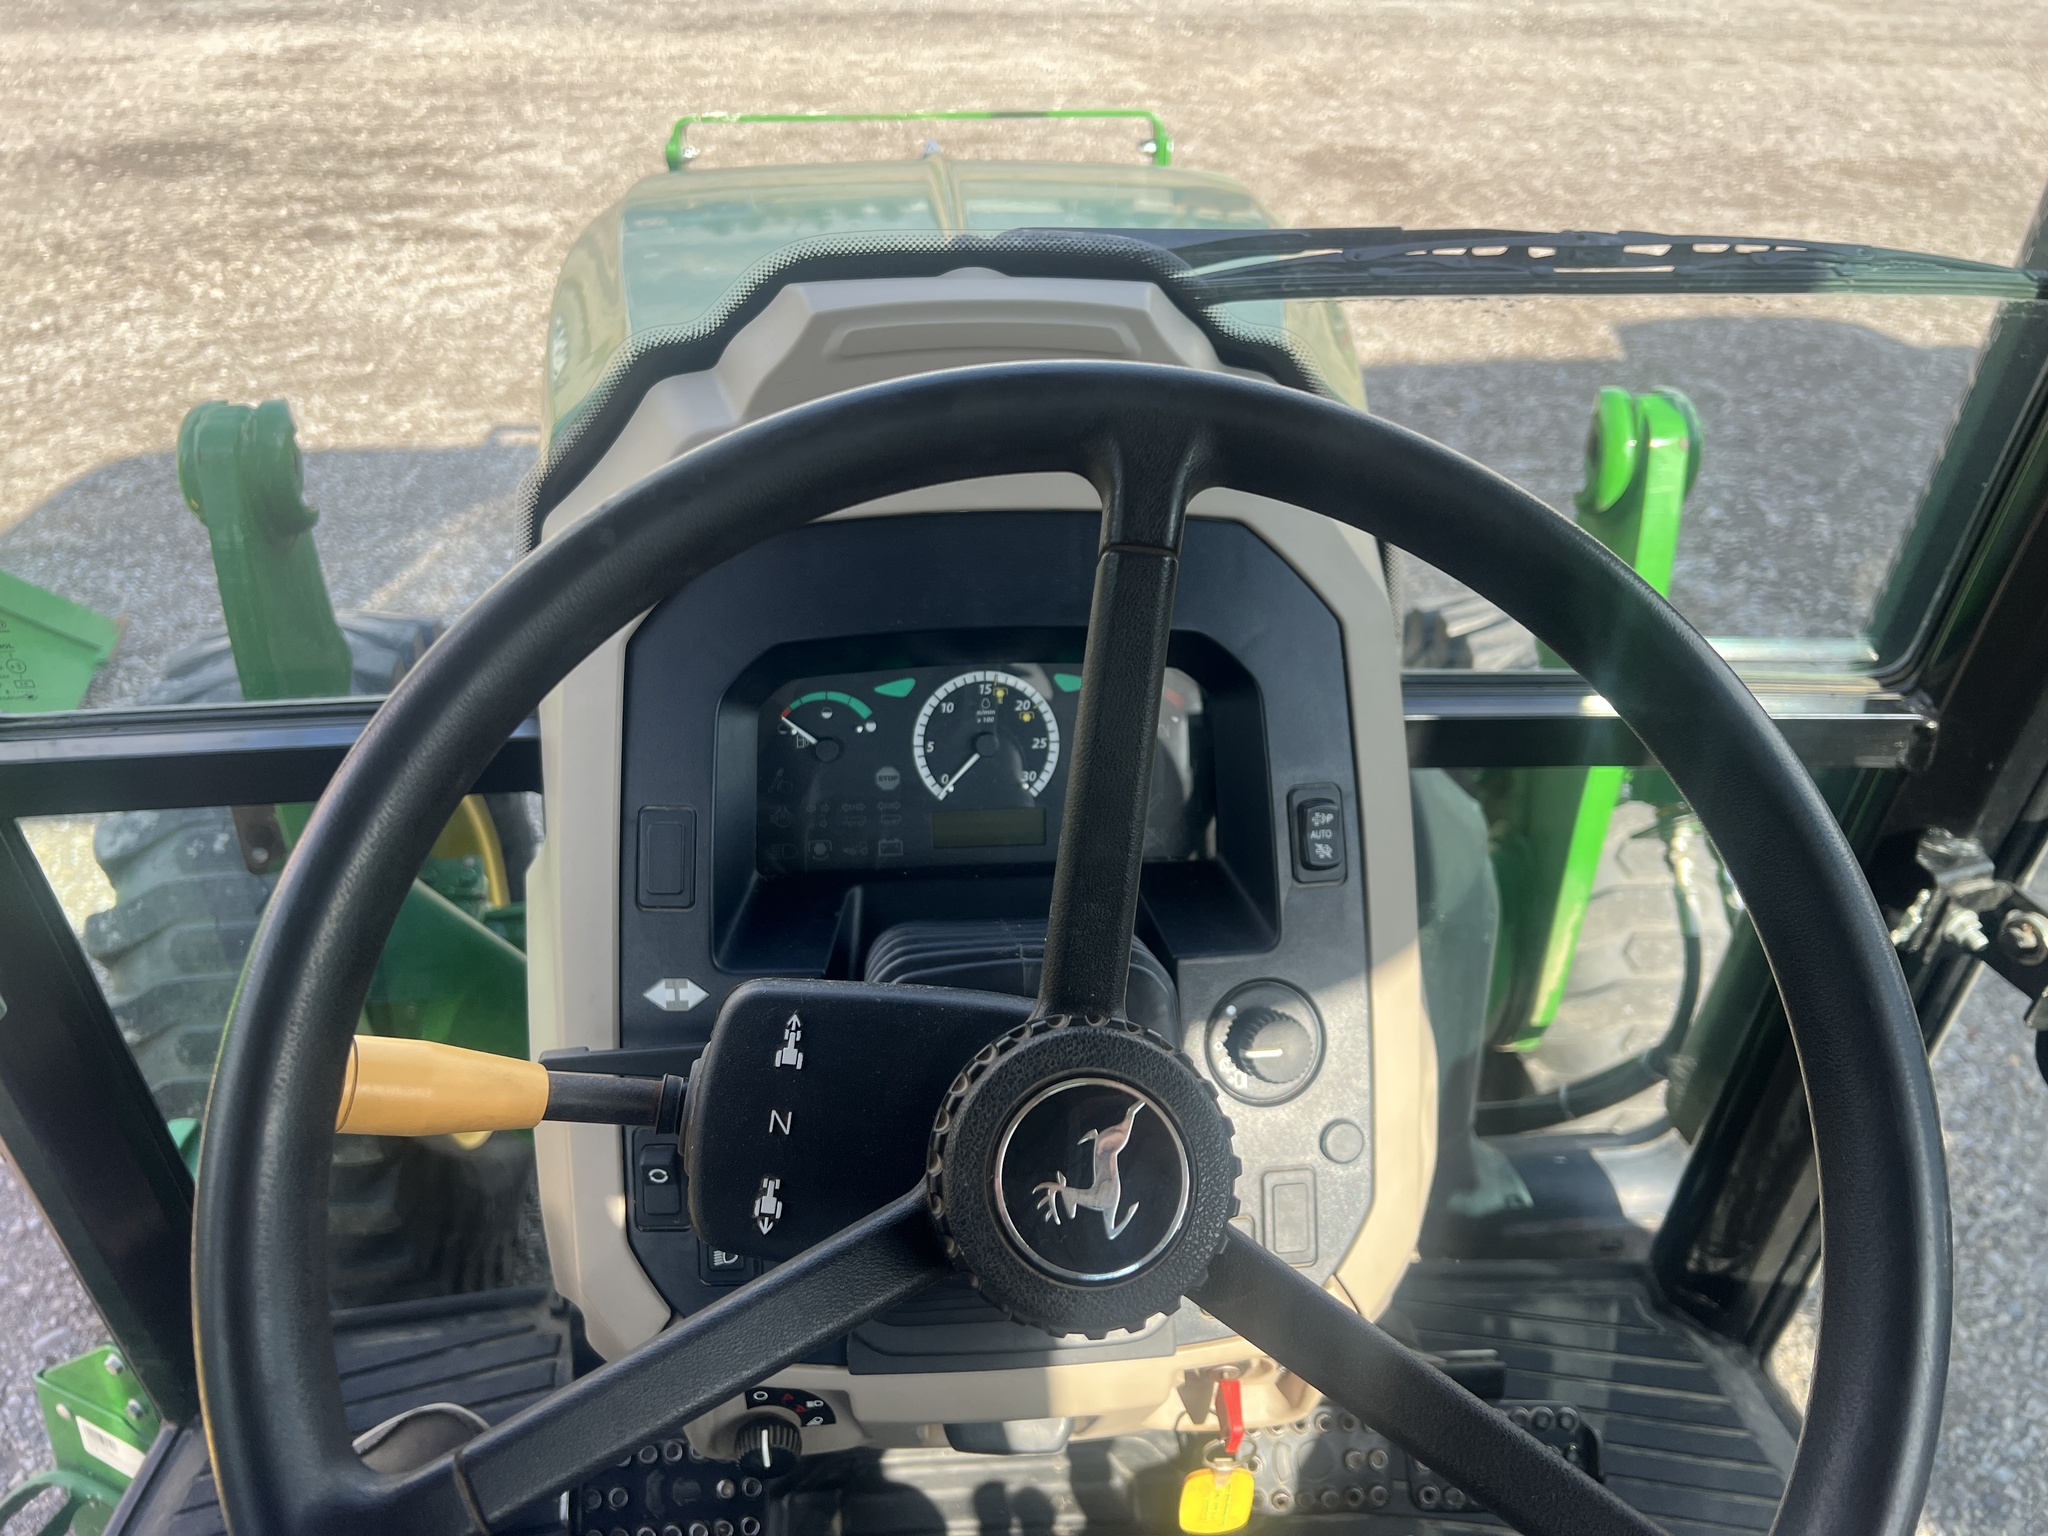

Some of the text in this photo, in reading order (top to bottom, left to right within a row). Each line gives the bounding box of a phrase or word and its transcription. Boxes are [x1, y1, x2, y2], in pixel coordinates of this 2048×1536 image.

[979, 684, 992, 695] 15
[941, 702, 954, 713] 10
[1015, 700, 1031, 711] 20
[927, 741, 935, 752] 5
[1032, 738, 1047, 749] 25
[941, 774, 949, 784] 0
[1022, 771, 1037, 782] 30
[1311, 829, 1332, 840] AUTO
[768, 1109, 793, 1136] N
